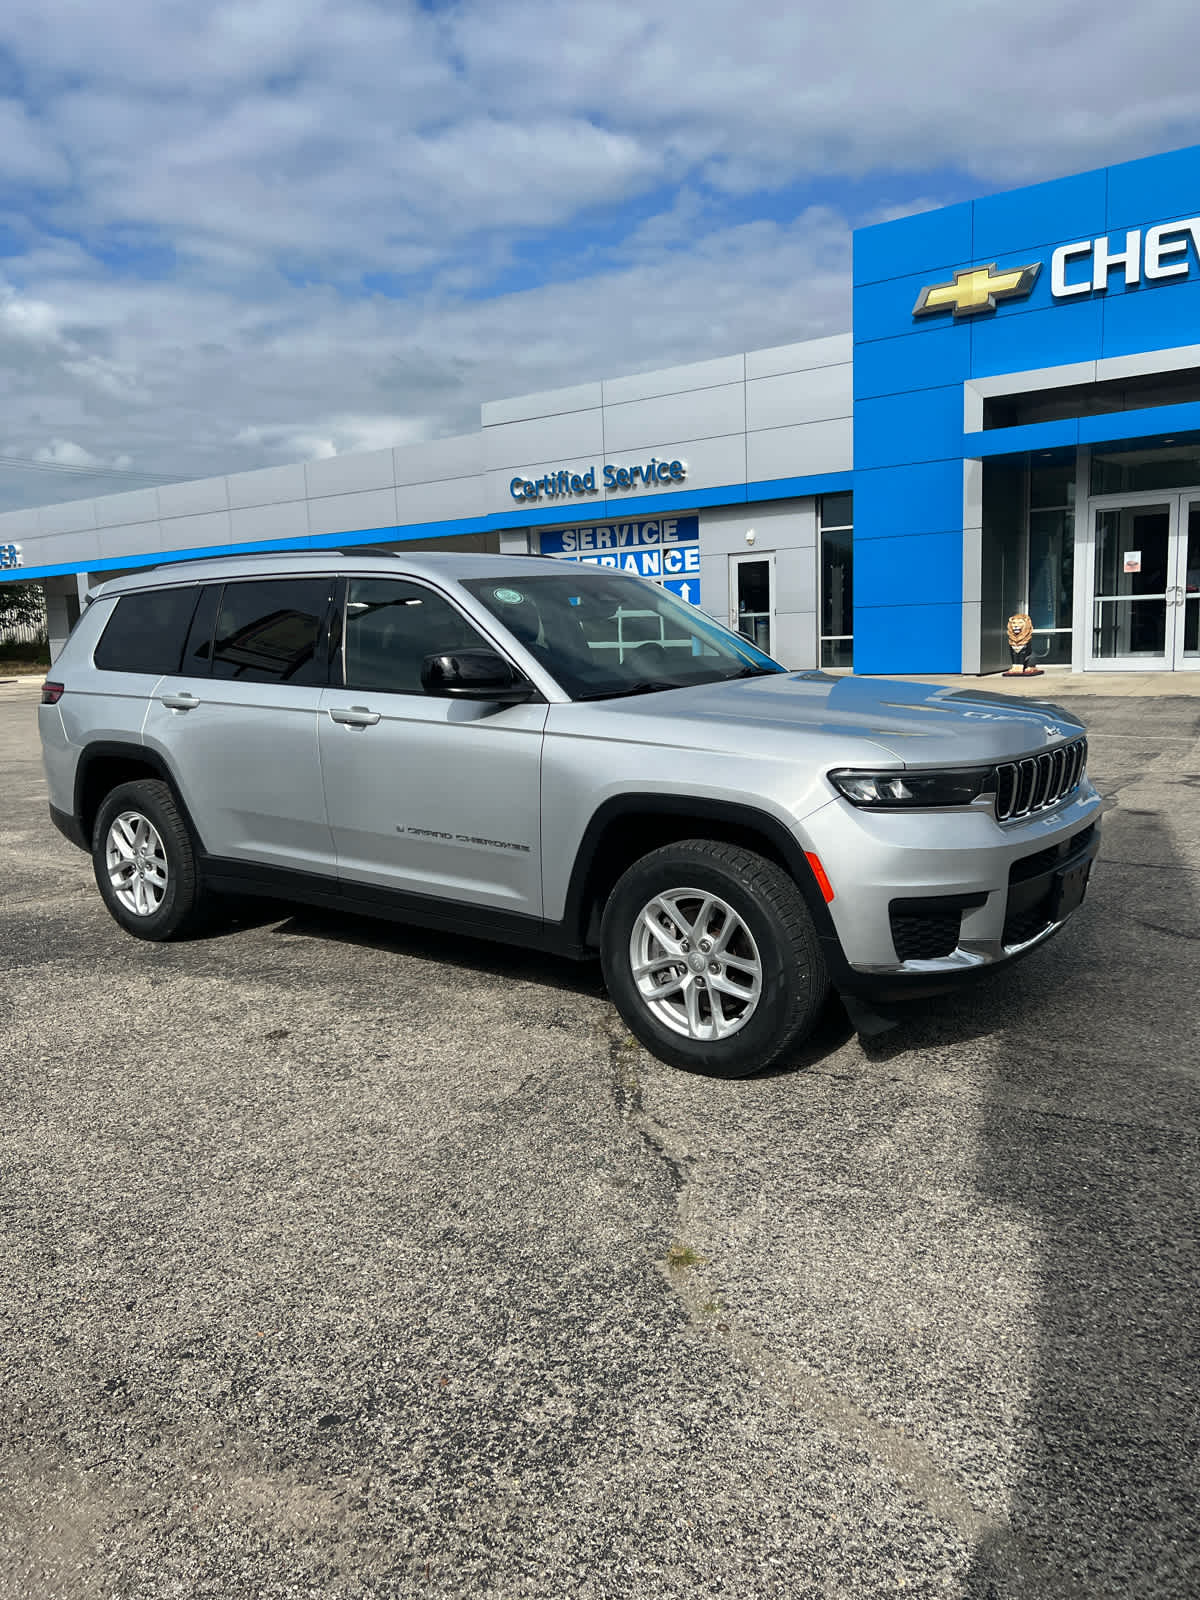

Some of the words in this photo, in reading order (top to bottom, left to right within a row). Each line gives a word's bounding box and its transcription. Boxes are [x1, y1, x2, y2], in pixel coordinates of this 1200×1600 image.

[509, 466, 596, 499] Certified
[602, 457, 683, 488] Service
[562, 520, 679, 552] SERVICE
